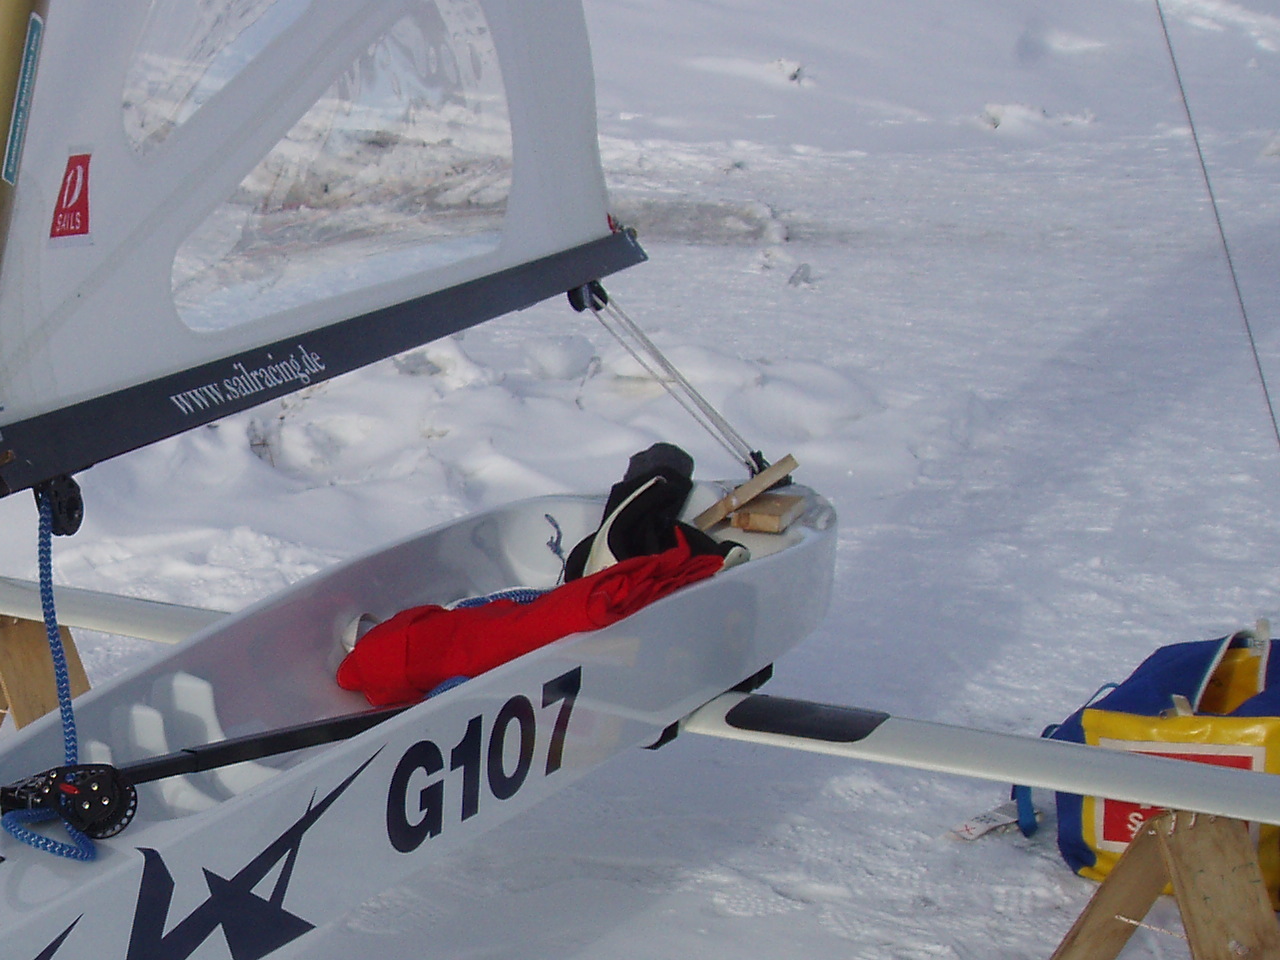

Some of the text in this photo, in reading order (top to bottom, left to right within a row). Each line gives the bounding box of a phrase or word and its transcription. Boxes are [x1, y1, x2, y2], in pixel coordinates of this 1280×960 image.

[56, 211, 82, 233] SAILS
[169, 344, 326, 416] www.sailracing.de
[386, 665, 582, 854] G107
